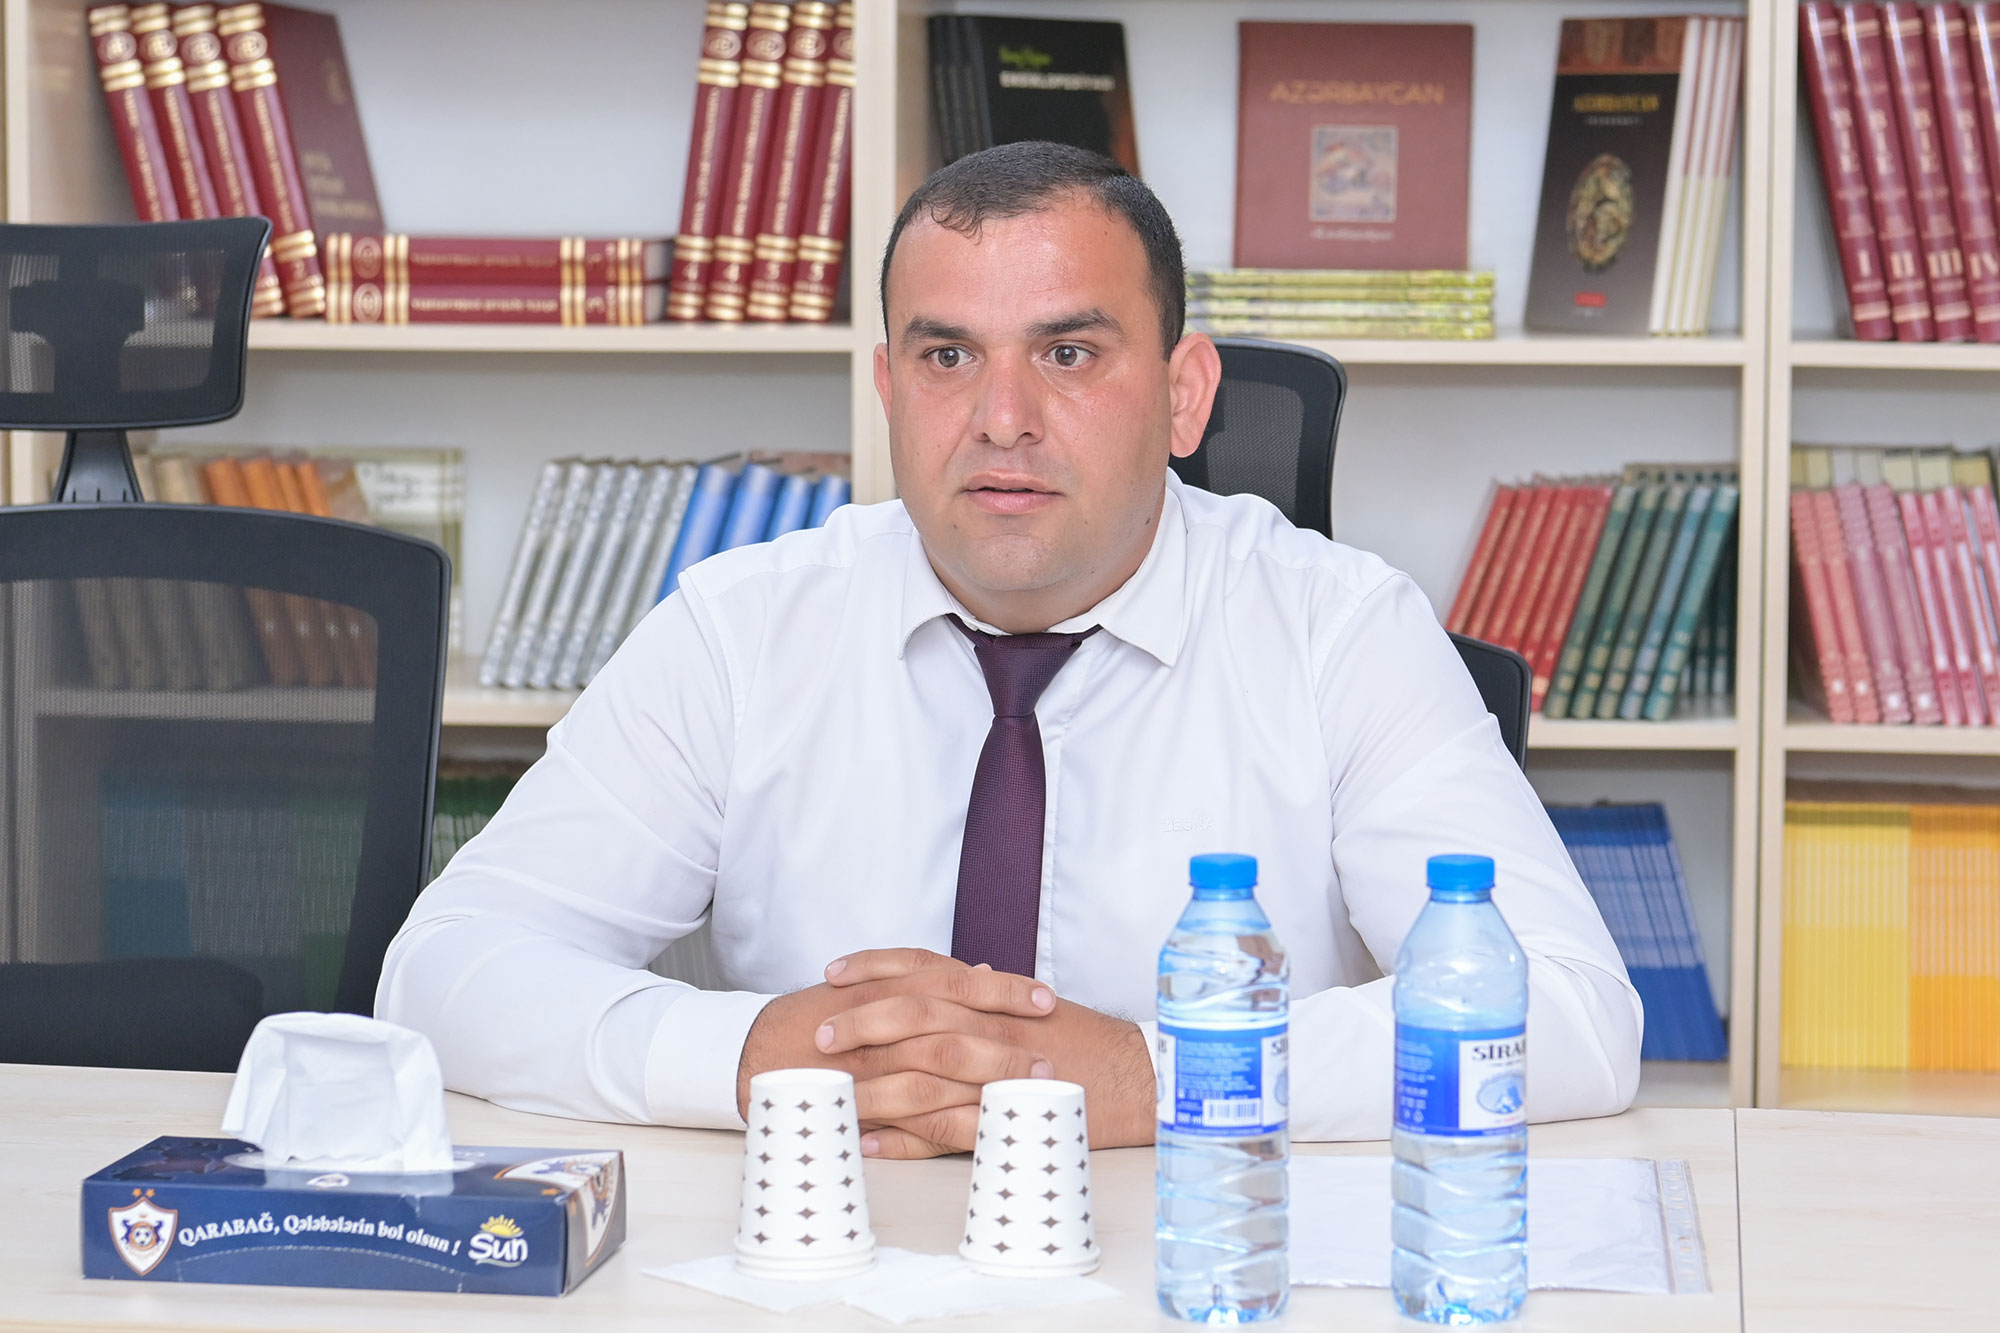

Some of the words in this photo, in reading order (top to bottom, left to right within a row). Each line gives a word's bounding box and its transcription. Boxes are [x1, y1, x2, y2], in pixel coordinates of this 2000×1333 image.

[1268, 79, 1446, 105] AZƏRBAYCAN
[1927, 247, 1964, 279] III
[178, 1211, 280, 1247] QARABAĞ,
[283, 1214, 375, 1237] Qələbələrin
[377, 1220, 405, 1242] bol
[405, 1228, 451, 1254] olsun
[468, 1232, 529, 1262] Sun
